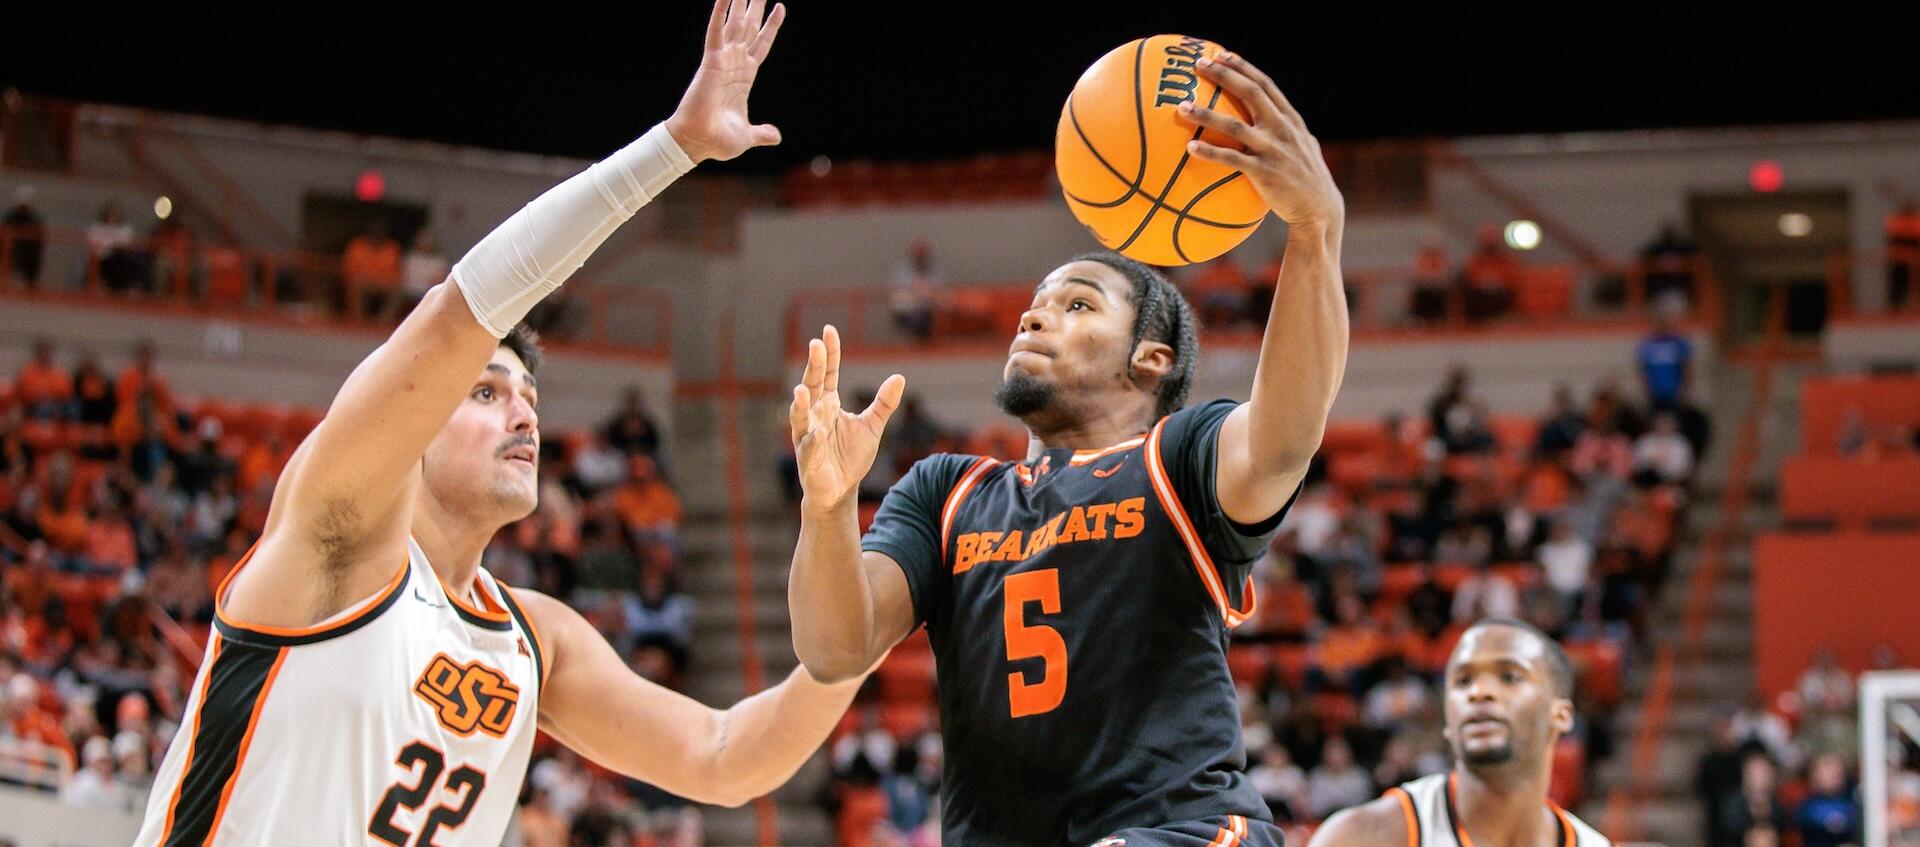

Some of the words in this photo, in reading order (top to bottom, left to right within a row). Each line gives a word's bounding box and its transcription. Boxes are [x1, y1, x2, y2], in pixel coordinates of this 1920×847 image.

[1155, 36, 1204, 107] Wils
[953, 497, 1145, 574] BEARKATS
[1004, 568, 1068, 718] 5
[414, 652, 520, 738] OSU
[368, 741, 486, 847] 22
